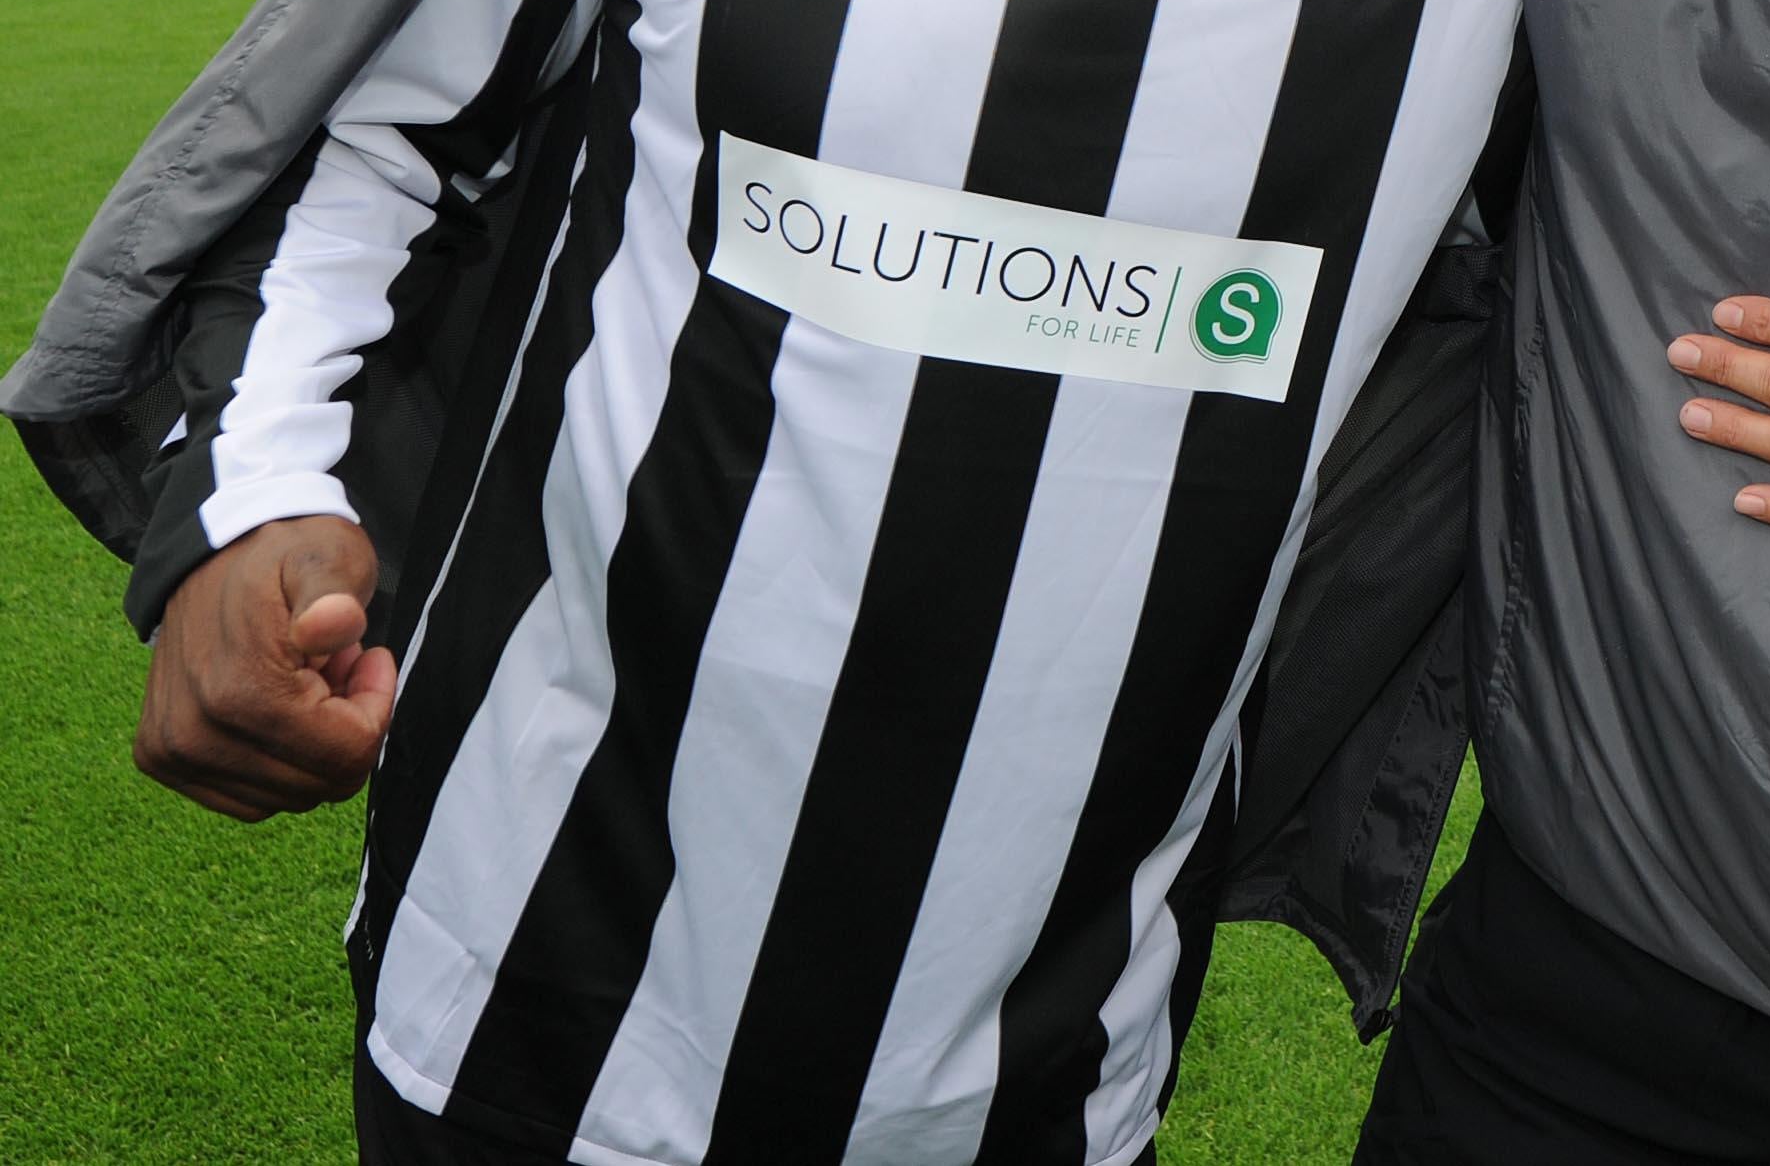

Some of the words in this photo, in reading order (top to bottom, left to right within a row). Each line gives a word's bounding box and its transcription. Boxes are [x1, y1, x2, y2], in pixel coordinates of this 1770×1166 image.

[743, 181, 1157, 318] SOLUTIONS
[1026, 314, 1079, 339] FOR
[1089, 323, 1141, 347] LIFE
[1211, 282, 1261, 345] S
